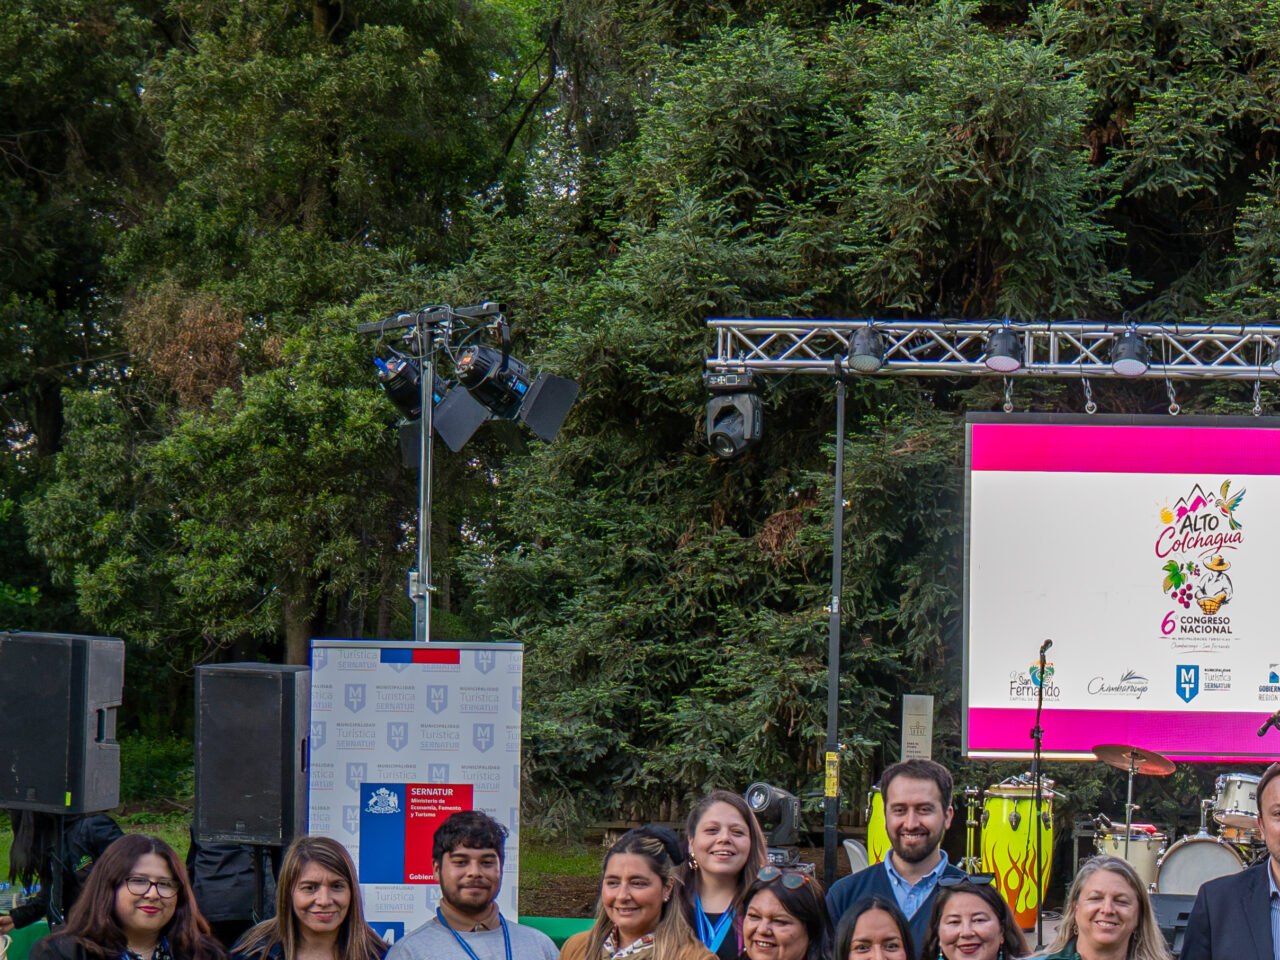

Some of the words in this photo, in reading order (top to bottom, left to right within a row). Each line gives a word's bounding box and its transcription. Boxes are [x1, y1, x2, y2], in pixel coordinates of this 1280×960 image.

[1179, 513, 1220, 535] ALTO
[1155, 526, 1243, 558] Colchagua
[1180, 616, 1231, 625] CONGRESO
[1180, 625, 1233, 634] NACIONAL
[1019, 675, 1031, 686] San
[411, 788, 454, 796] SERNATUR
